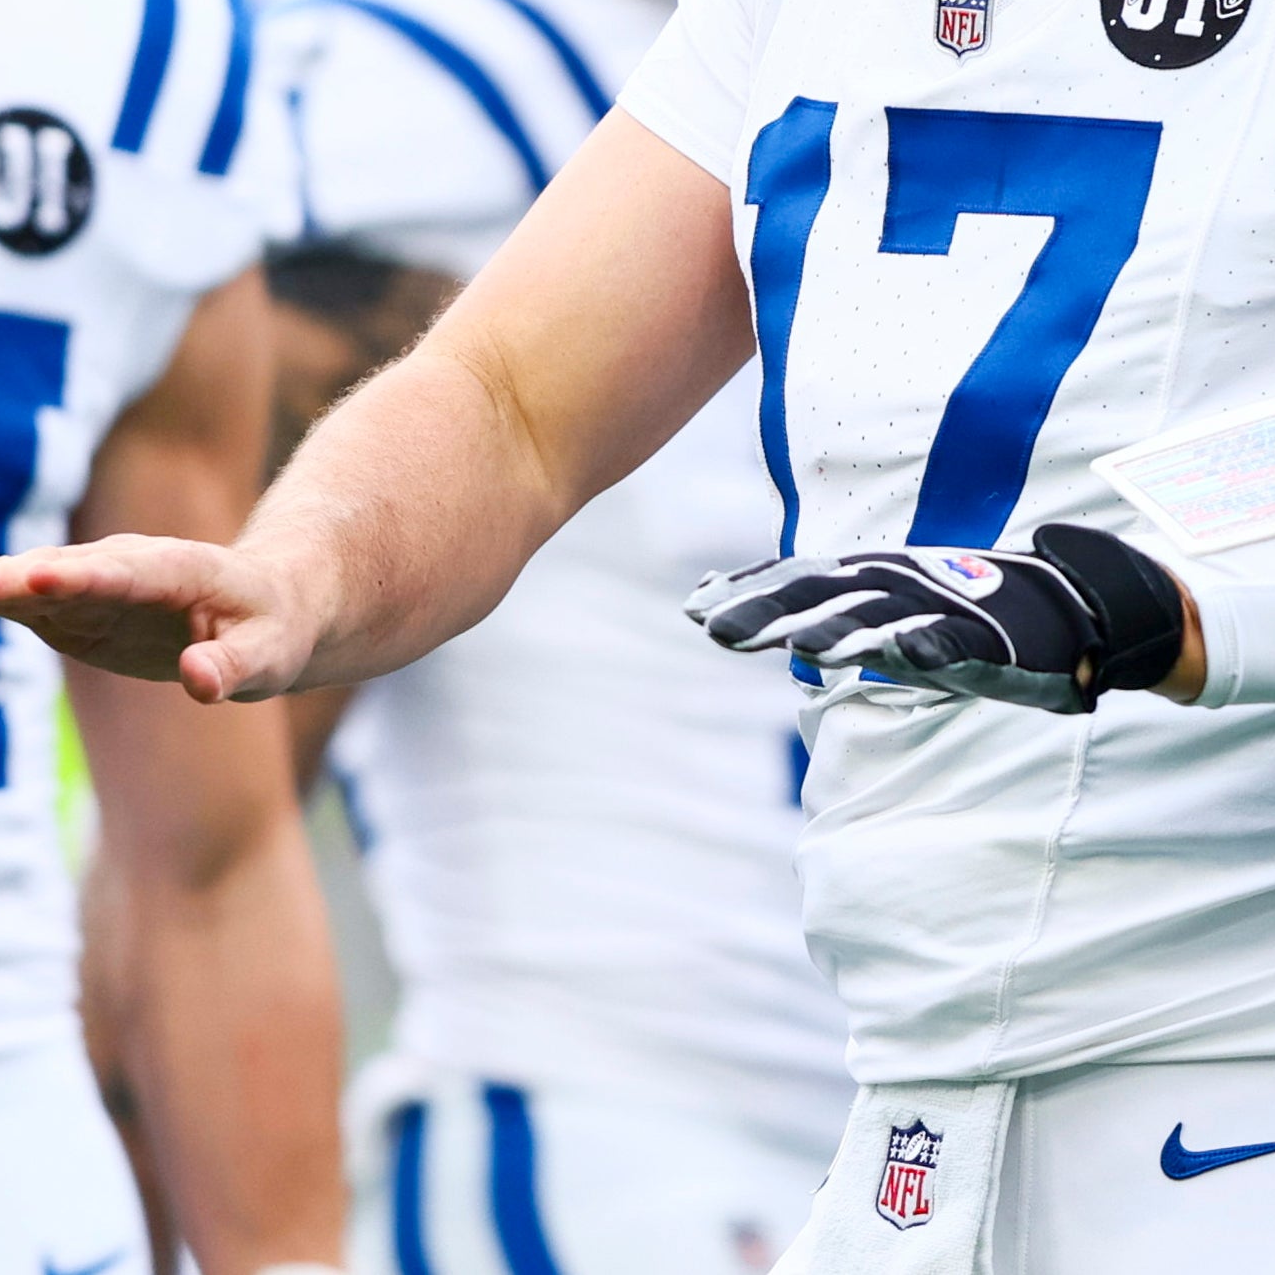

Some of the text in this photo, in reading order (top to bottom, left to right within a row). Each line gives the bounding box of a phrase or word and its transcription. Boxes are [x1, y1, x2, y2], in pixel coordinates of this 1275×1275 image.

[942, 10, 981, 46] NFL
[745, 95, 1164, 687] 17
[880, 1165, 931, 1218] NFL
